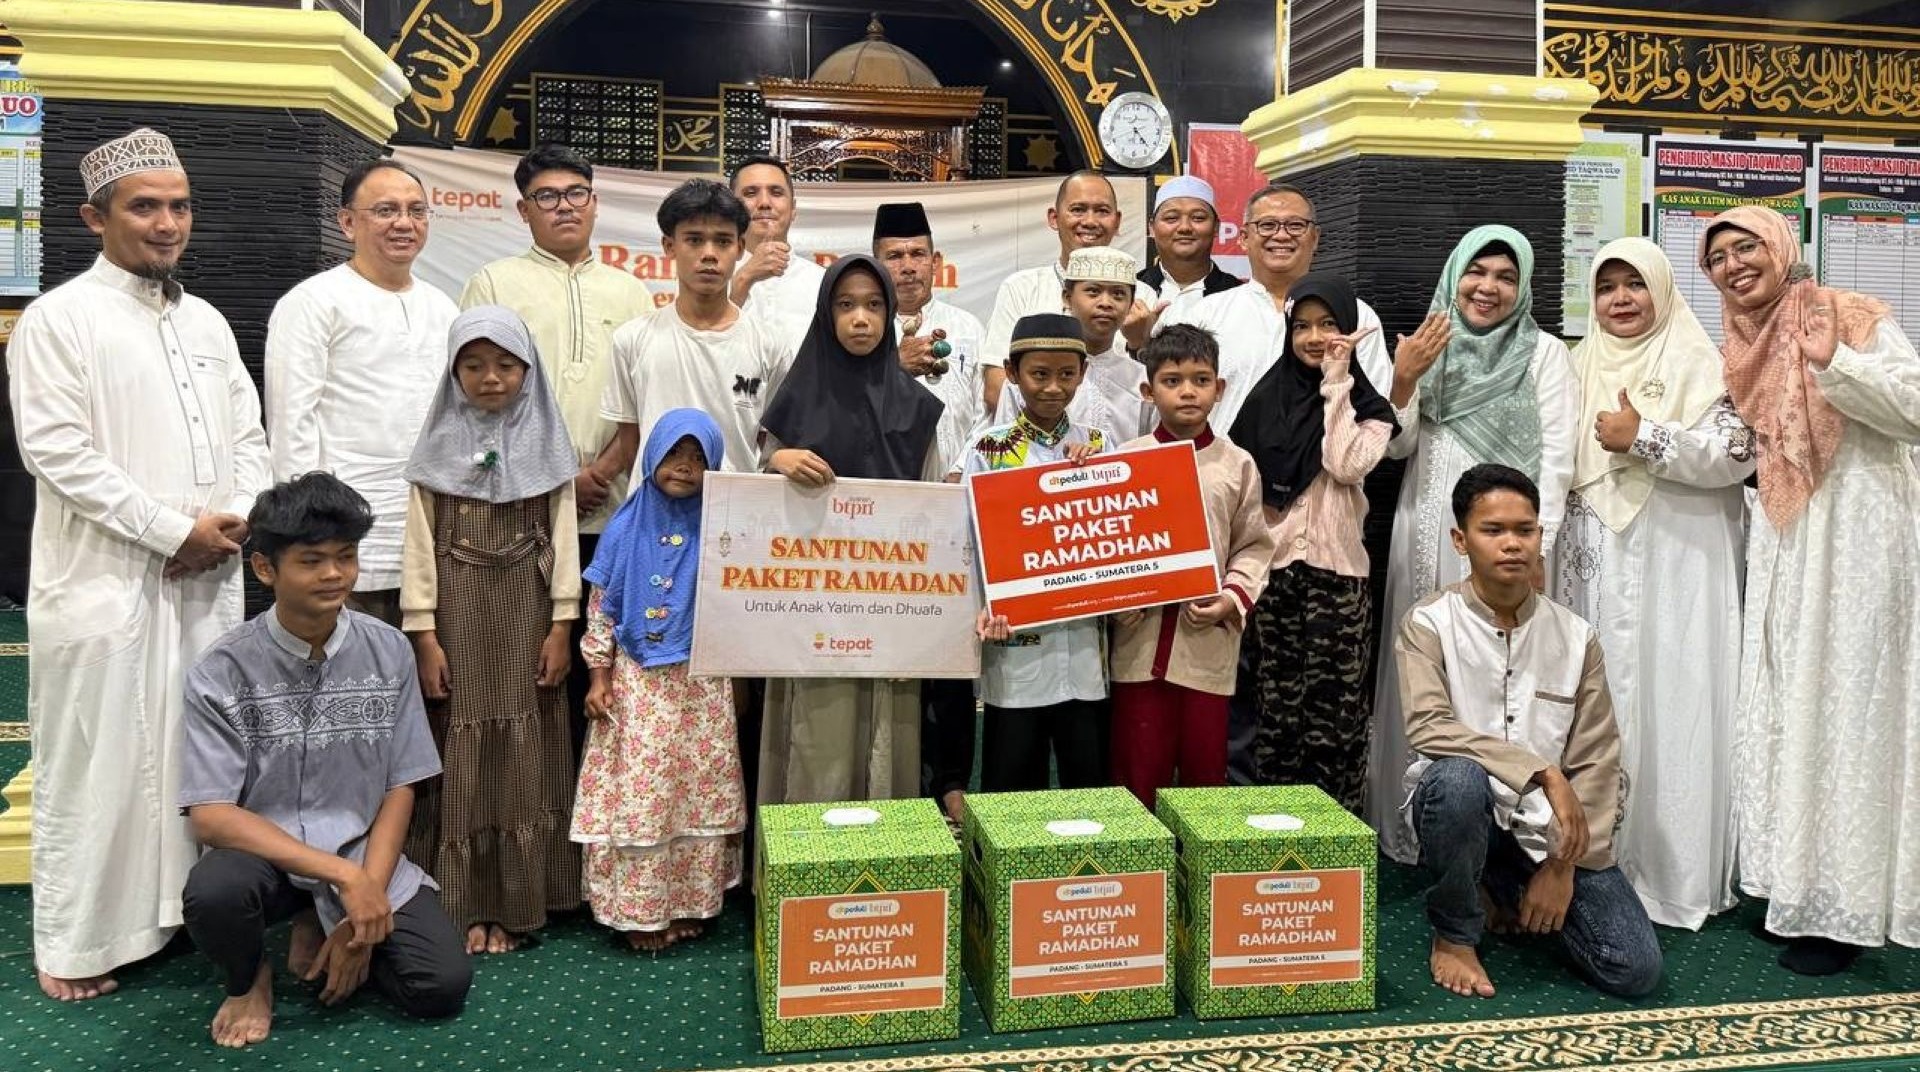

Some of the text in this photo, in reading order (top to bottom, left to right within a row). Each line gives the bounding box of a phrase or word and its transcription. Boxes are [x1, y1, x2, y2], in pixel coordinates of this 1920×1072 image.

[0, 96, 37, 115] UO
[1659, 149, 1710, 168] PENGURUS
[1710, 151, 1746, 170] MASJID
[1747, 153, 1781, 172] TAQWA
[1822, 155, 1871, 174] PENGURUS
[1871, 157, 1906, 176] MASJID
[432, 187, 502, 212] tepat
[1662, 194, 1678, 204] KAS
[1021, 488, 1159, 525] SANTUNAN
[1054, 514, 1133, 544] PAKET
[770, 536, 929, 564] SANTUNAN
[1023, 531, 1172, 571] RAMADHAN
[721, 566, 967, 596] PAKET RAMADAN
[1043, 572, 1088, 587] PADANG
[1096, 563, 1151, 579] SUMATERA
[1152, 561, 1160, 570] 5
[744, 599, 943, 617] Untuk Anak Yatim dan Dhuafa
[830, 637, 873, 653] tepat
[1042, 903, 1136, 924] SANTUNAN
[1241, 899, 1334, 917] SANTUNAN
[1062, 921, 1118, 937] PAKET
[1261, 915, 1316, 930] PAKET
[813, 923, 914, 943] SANTUNAN
[1238, 929, 1337, 947] RAMADHAN
[834, 940, 894, 957] PAKET
[1038, 935, 1140, 955] RAMADHAN
[809, 955, 917, 975] RAMADHAN
[1049, 963, 1079, 973] PADANG
[1084, 961, 1123, 971] SUMATERA
[1248, 956, 1278, 965] PADANG
[1283, 955, 1319, 964] SUMATERA
[819, 983, 852, 994] PADANG
[858, 981, 898, 992] SUMATERA
